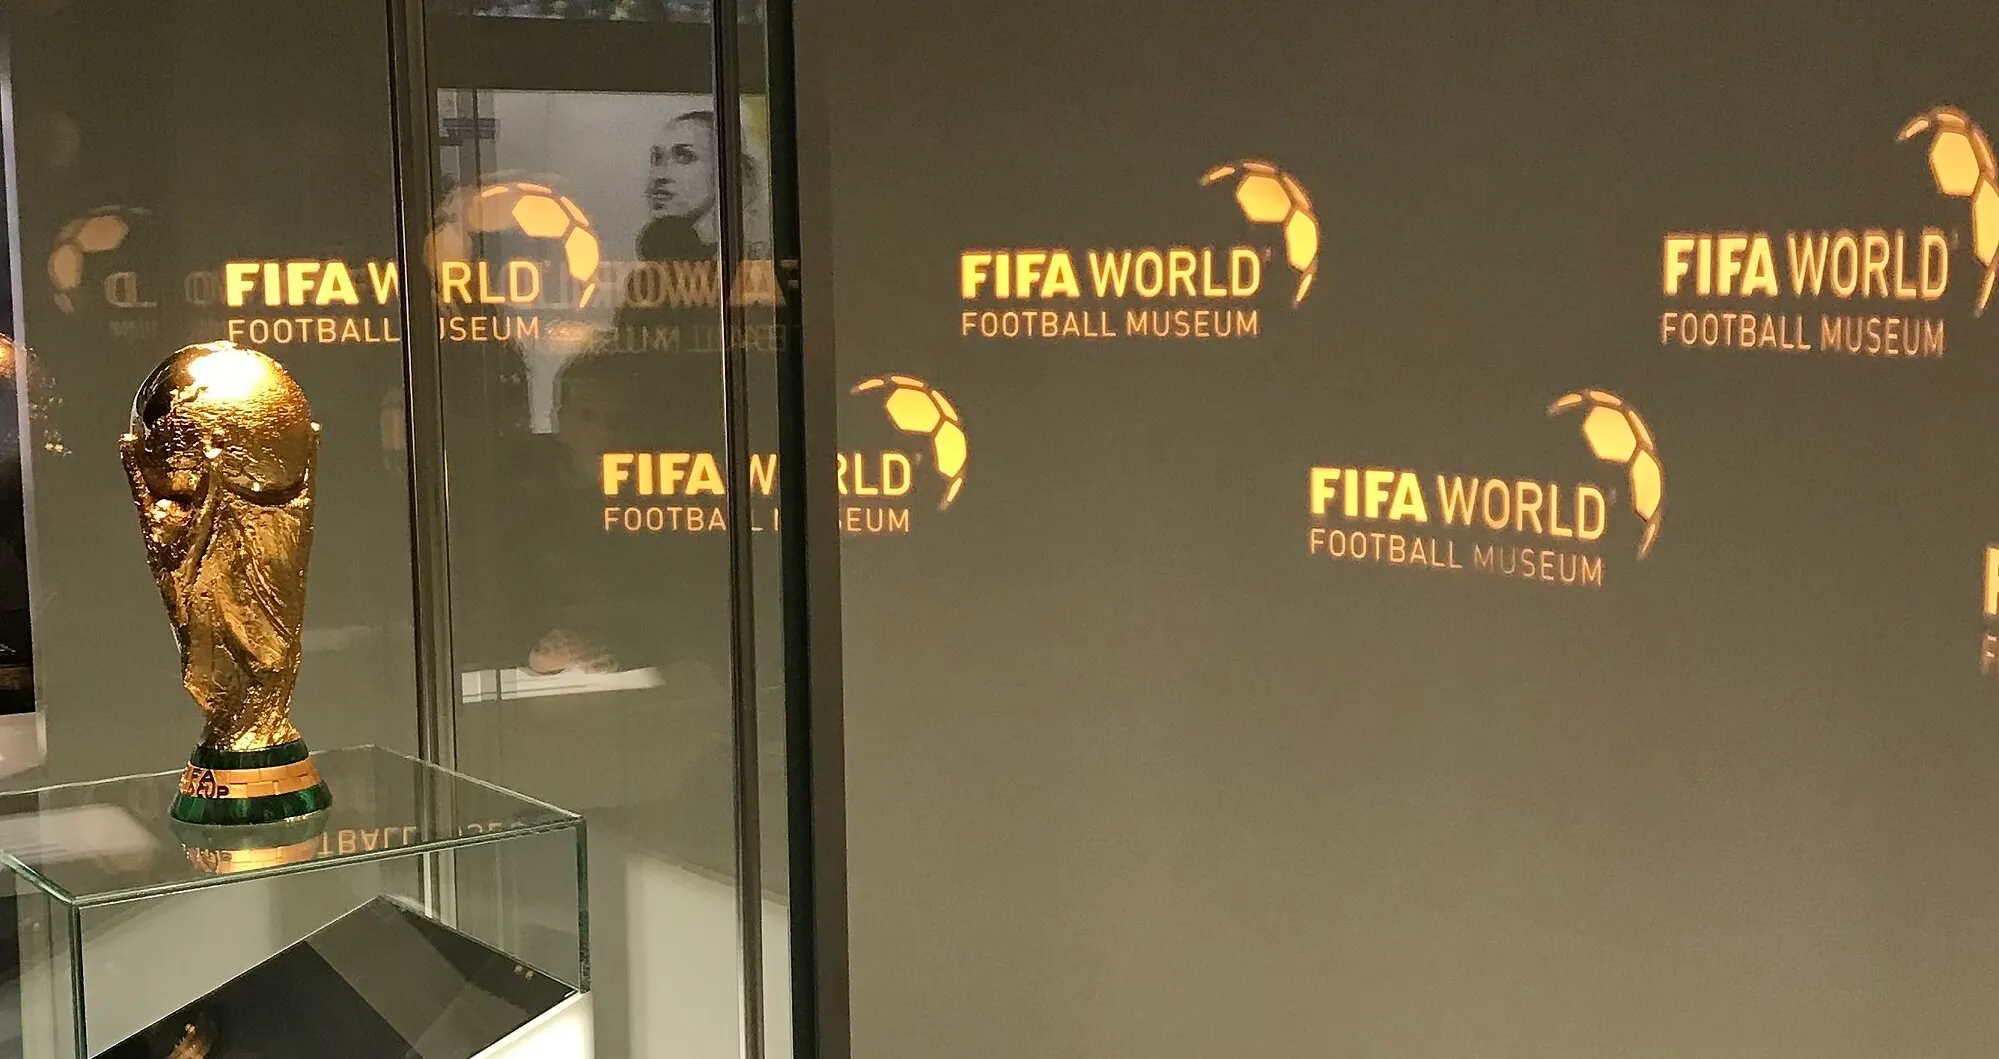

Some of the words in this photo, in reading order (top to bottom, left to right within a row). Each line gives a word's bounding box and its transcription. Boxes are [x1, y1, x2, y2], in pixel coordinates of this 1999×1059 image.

[224, 262, 359, 307] FIFA
[367, 260, 541, 307] WRLD
[960, 252, 1081, 300] FIFA
[1088, 248, 1262, 299] WORLD
[1663, 236, 1780, 298] FIFA
[1787, 232, 1949, 299] WORLD
[227, 317, 401, 344] FOOTBALL
[438, 315, 540, 342] SEUM
[961, 310, 1118, 338] FOOTBALL
[1126, 309, 1259, 337] MUSEUM
[1660, 311, 1812, 350] FOOTBALL
[1820, 315, 1946, 357] MUSEUM
[602, 452, 727, 496] FIFA
[748, 452, 912, 496] WLD
[604, 507, 765, 533] FOOTBA
[1309, 466, 1429, 523] FIFA
[1436, 474, 1606, 541] WORLD
[1309, 527, 1464, 570] FOOTBALL
[1473, 543, 1603, 587] MUSEUM
